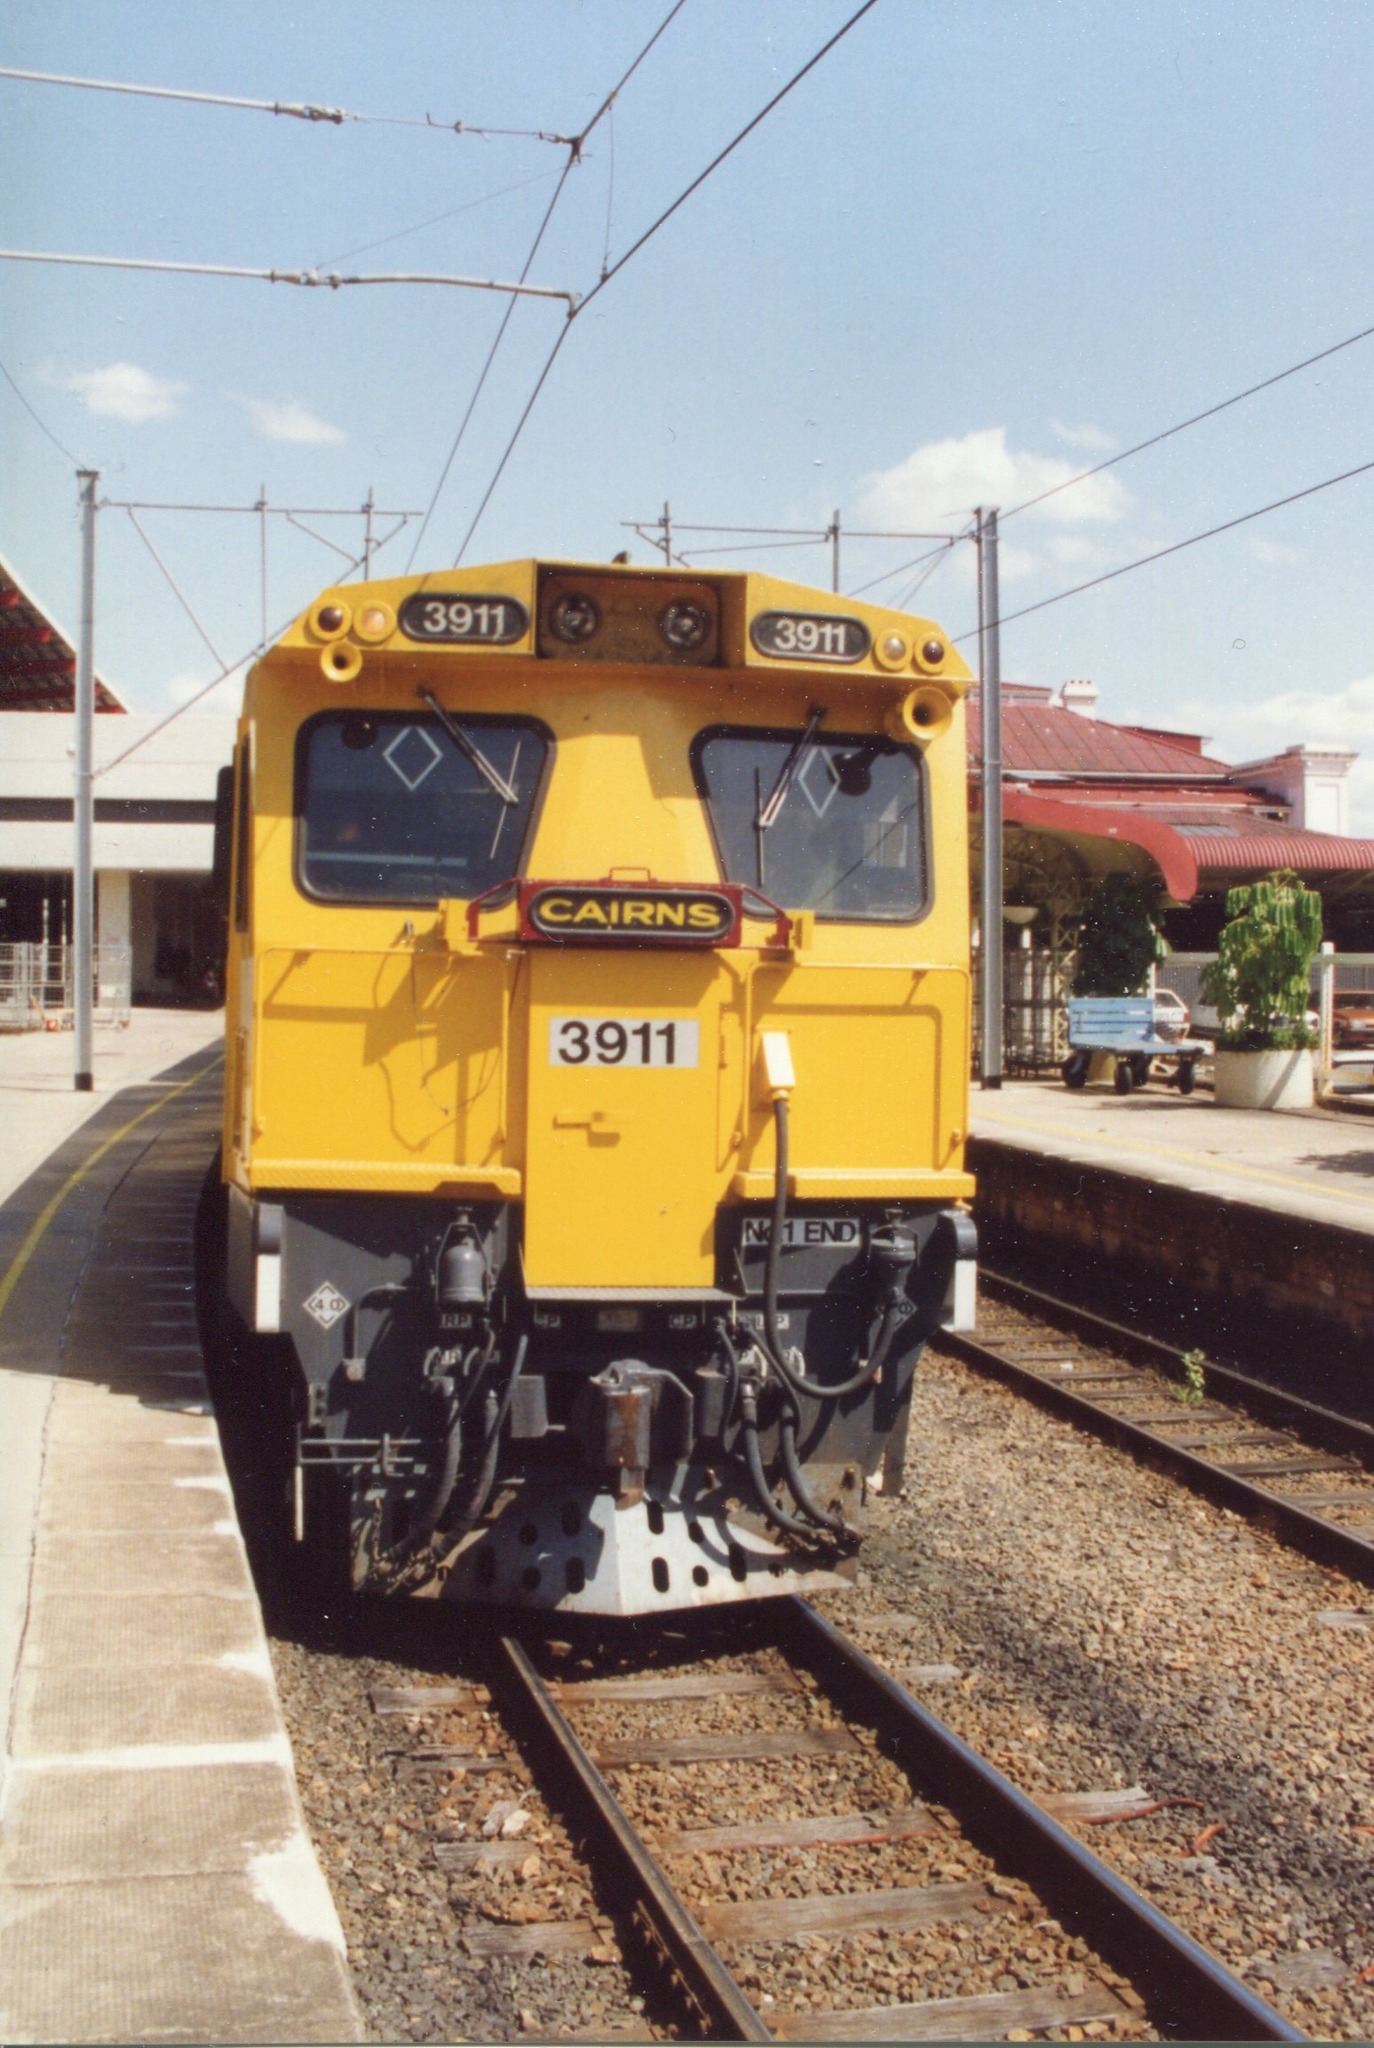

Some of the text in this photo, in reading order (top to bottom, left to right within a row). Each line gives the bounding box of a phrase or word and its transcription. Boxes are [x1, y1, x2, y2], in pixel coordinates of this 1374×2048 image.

[423, 602, 505, 636] 3911
[774, 619, 846, 654] 3911
[539, 898, 721, 928] CAIRNS
[558, 1020, 676, 1064] 3911
[783, 1220, 794, 1243] 1
[804, 1220, 857, 1243] END
